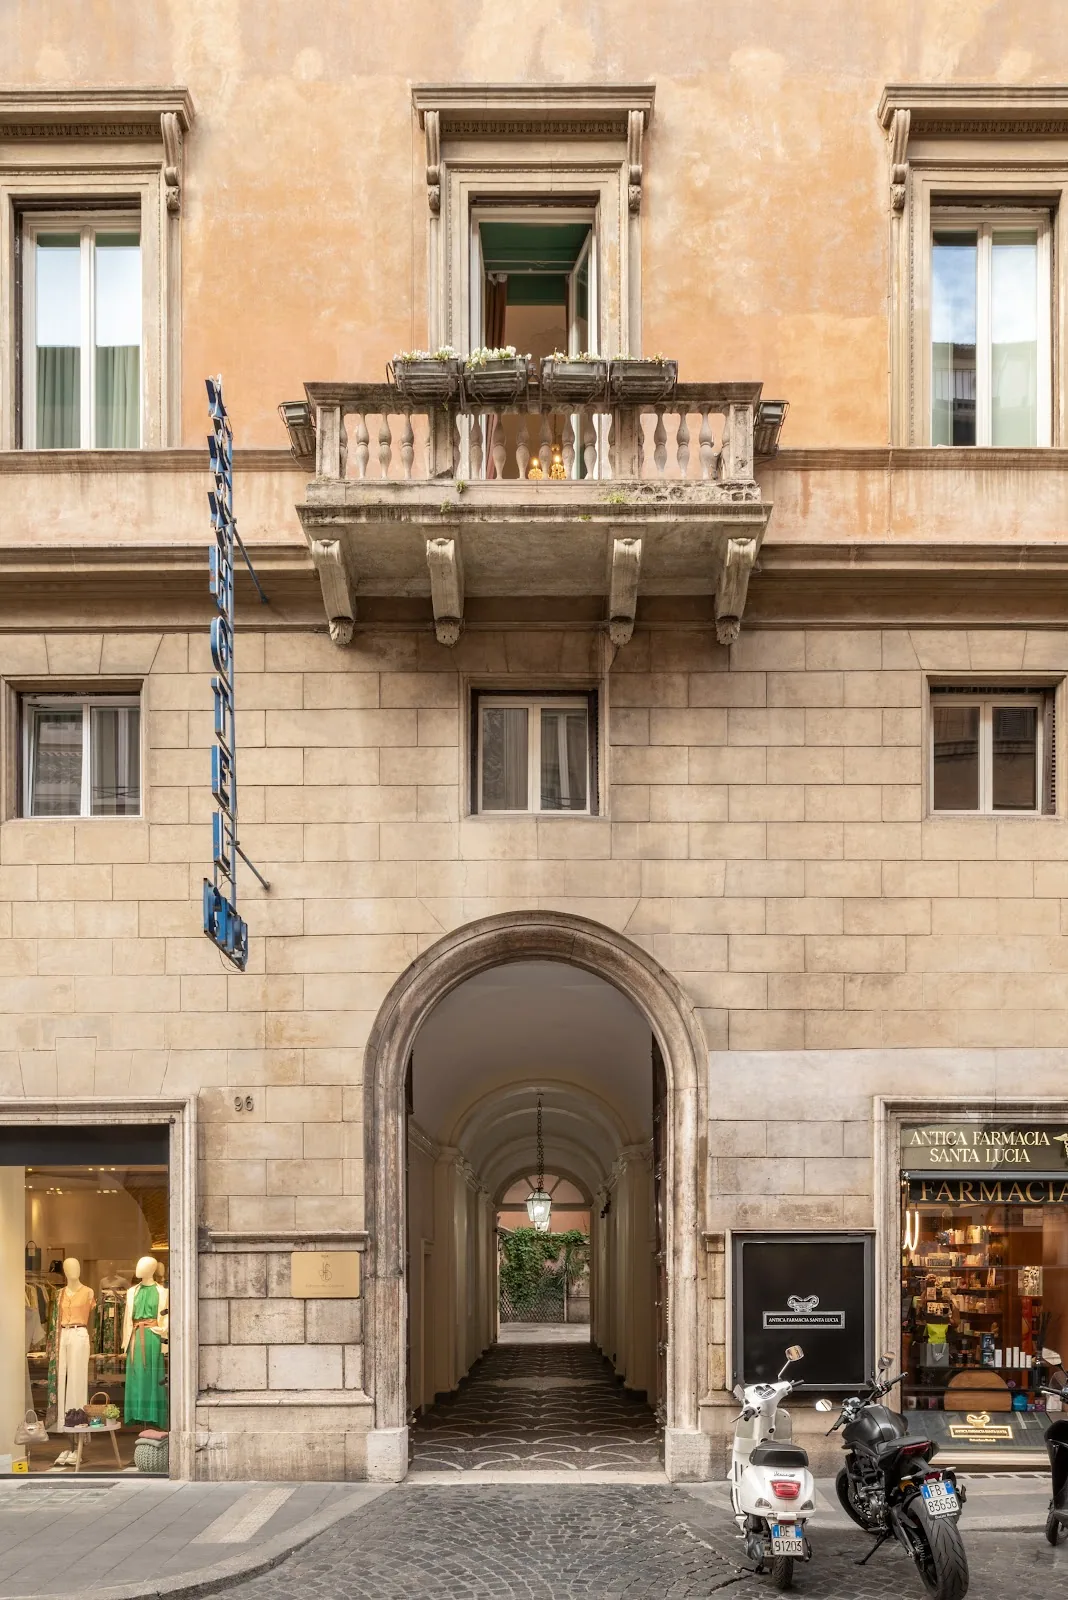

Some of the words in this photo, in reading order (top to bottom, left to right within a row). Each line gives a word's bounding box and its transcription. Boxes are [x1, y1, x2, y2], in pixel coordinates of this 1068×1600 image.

[234, 1096, 254, 1111] 96
[910, 1131, 968, 1146] ANTICA
[973, 1131, 1050, 1146] FARMACIA
[930, 1148, 981, 1163] SANTA
[986, 1148, 1031, 1163] LUCIA
[929, 1484, 941, 1496] FB
[928, 1497, 957, 1512] 83656
[780, 1525, 791, 1537] DE
[775, 1540, 802, 1552] 91203
